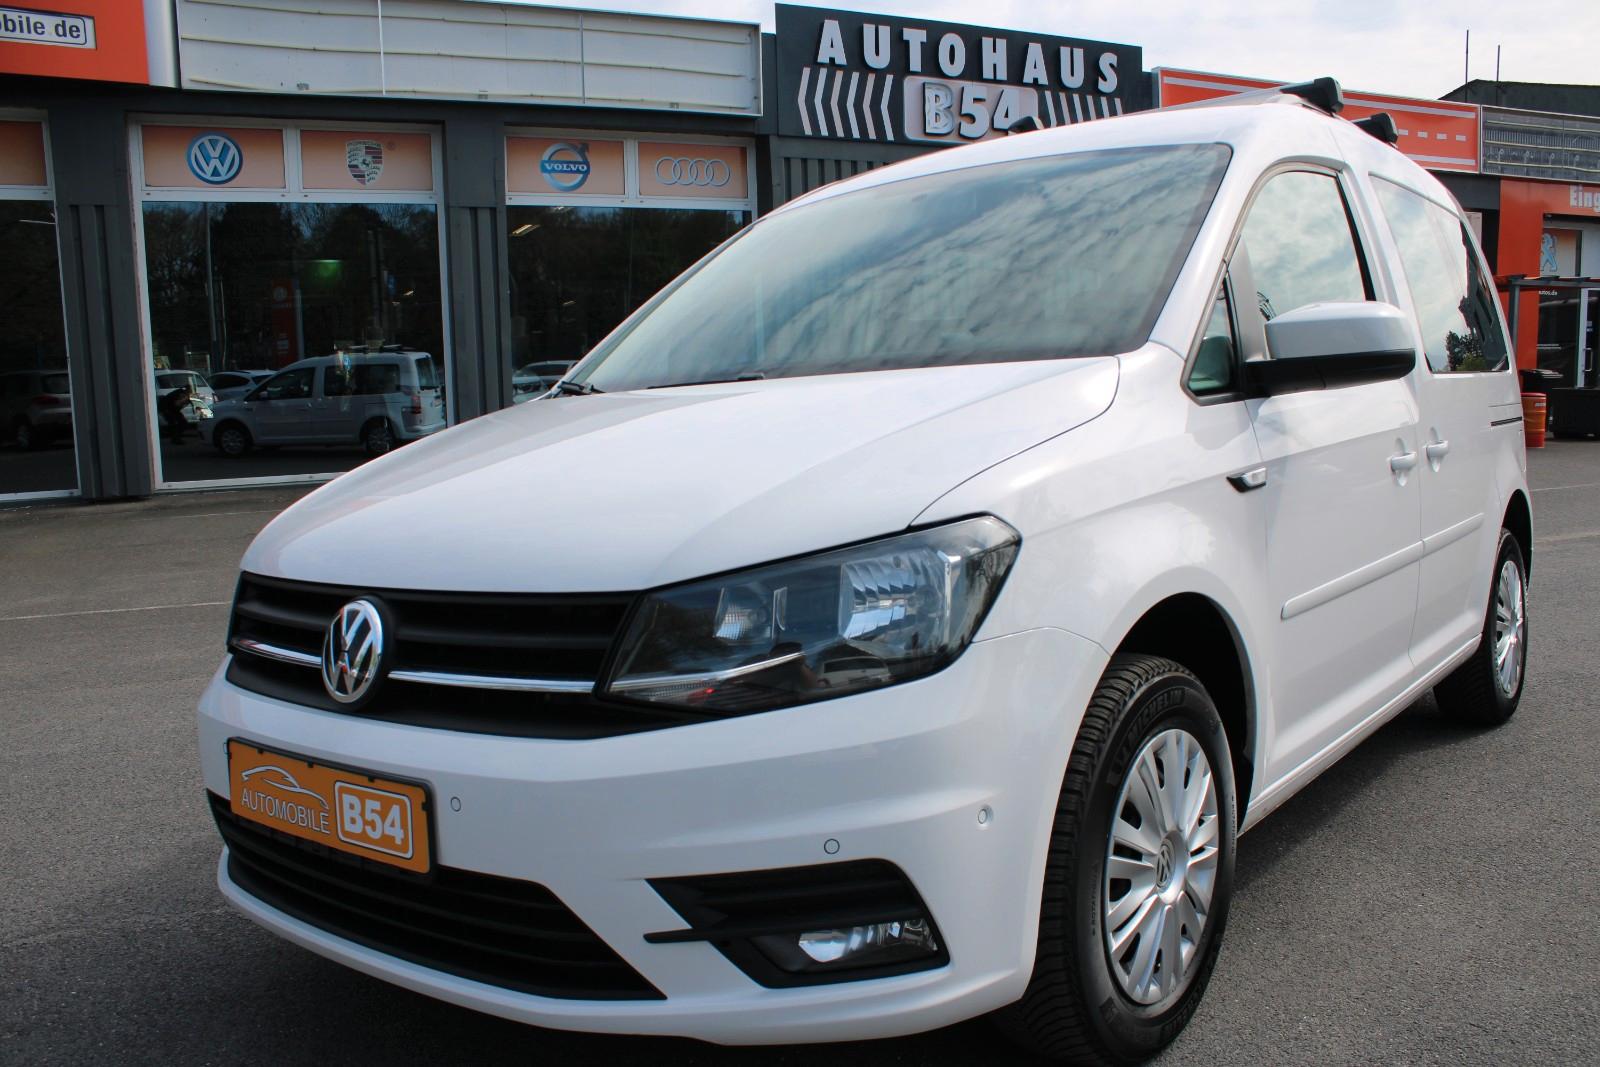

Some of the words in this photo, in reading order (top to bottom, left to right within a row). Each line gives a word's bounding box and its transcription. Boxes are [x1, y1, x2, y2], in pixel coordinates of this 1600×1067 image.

[0, 14, 46, 36] bile
[816, 19, 1119, 94] AUTOHAUS
[923, 81, 1020, 139] B54
[543, 163, 588, 172] VOLVO
[241, 788, 331, 835] AUTOMOBILE
[342, 793, 404, 845] B54
